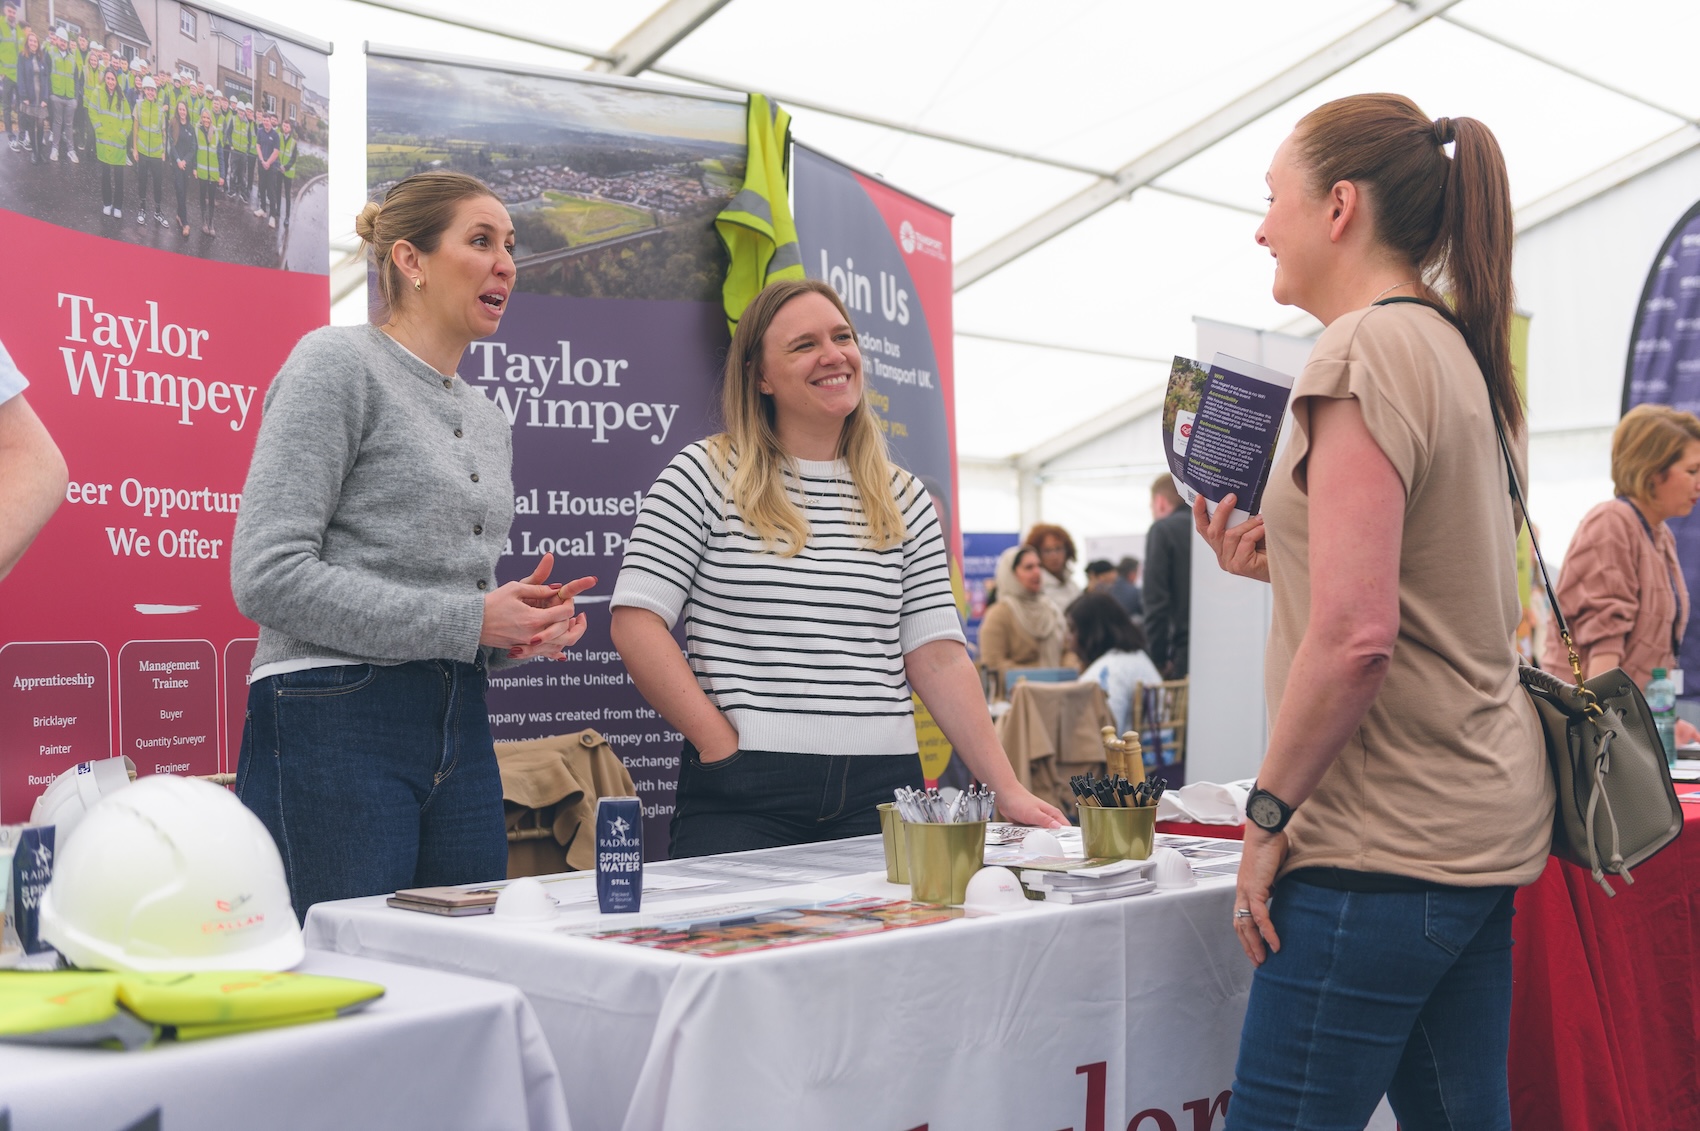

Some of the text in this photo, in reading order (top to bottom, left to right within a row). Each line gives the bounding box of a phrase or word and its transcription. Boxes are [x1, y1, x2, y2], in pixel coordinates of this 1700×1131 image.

[821, 249, 910, 325] Join Us
[58, 292, 209, 366] Taylor
[883, 336, 900, 358] bus
[470, 340, 629, 398] Taylor
[874, 358, 916, 385] Transport
[59, 346, 257, 431] Wimpey
[105, 527, 223, 559] We Offer
[521, 531, 595, 556] Local
[139, 660, 200, 674] Management
[13, 673, 95, 691] Apprenticeship
[152, 677, 189, 689] Trainee
[547, 675, 557, 686] in
[561, 674, 580, 686] the
[584, 673, 623, 686] United
[33, 715, 77, 728] Bricklayer
[160, 709, 183, 720] Buyer
[529, 712, 552, 722] was
[555, 708, 600, 721] created
[604, 708, 632, 720] from
[635, 707, 655, 719] the
[135, 734, 206, 749] Quantity Surveyor
[645, 733, 660, 743] on
[39, 744, 72, 756] Painter
[155, 762, 190, 775] Engineer
[623, 756, 680, 769] Exchange
[600, 838, 640, 847] RADNOR
[600, 851, 640, 862] SPRING
[600, 862, 640, 873] WATER
